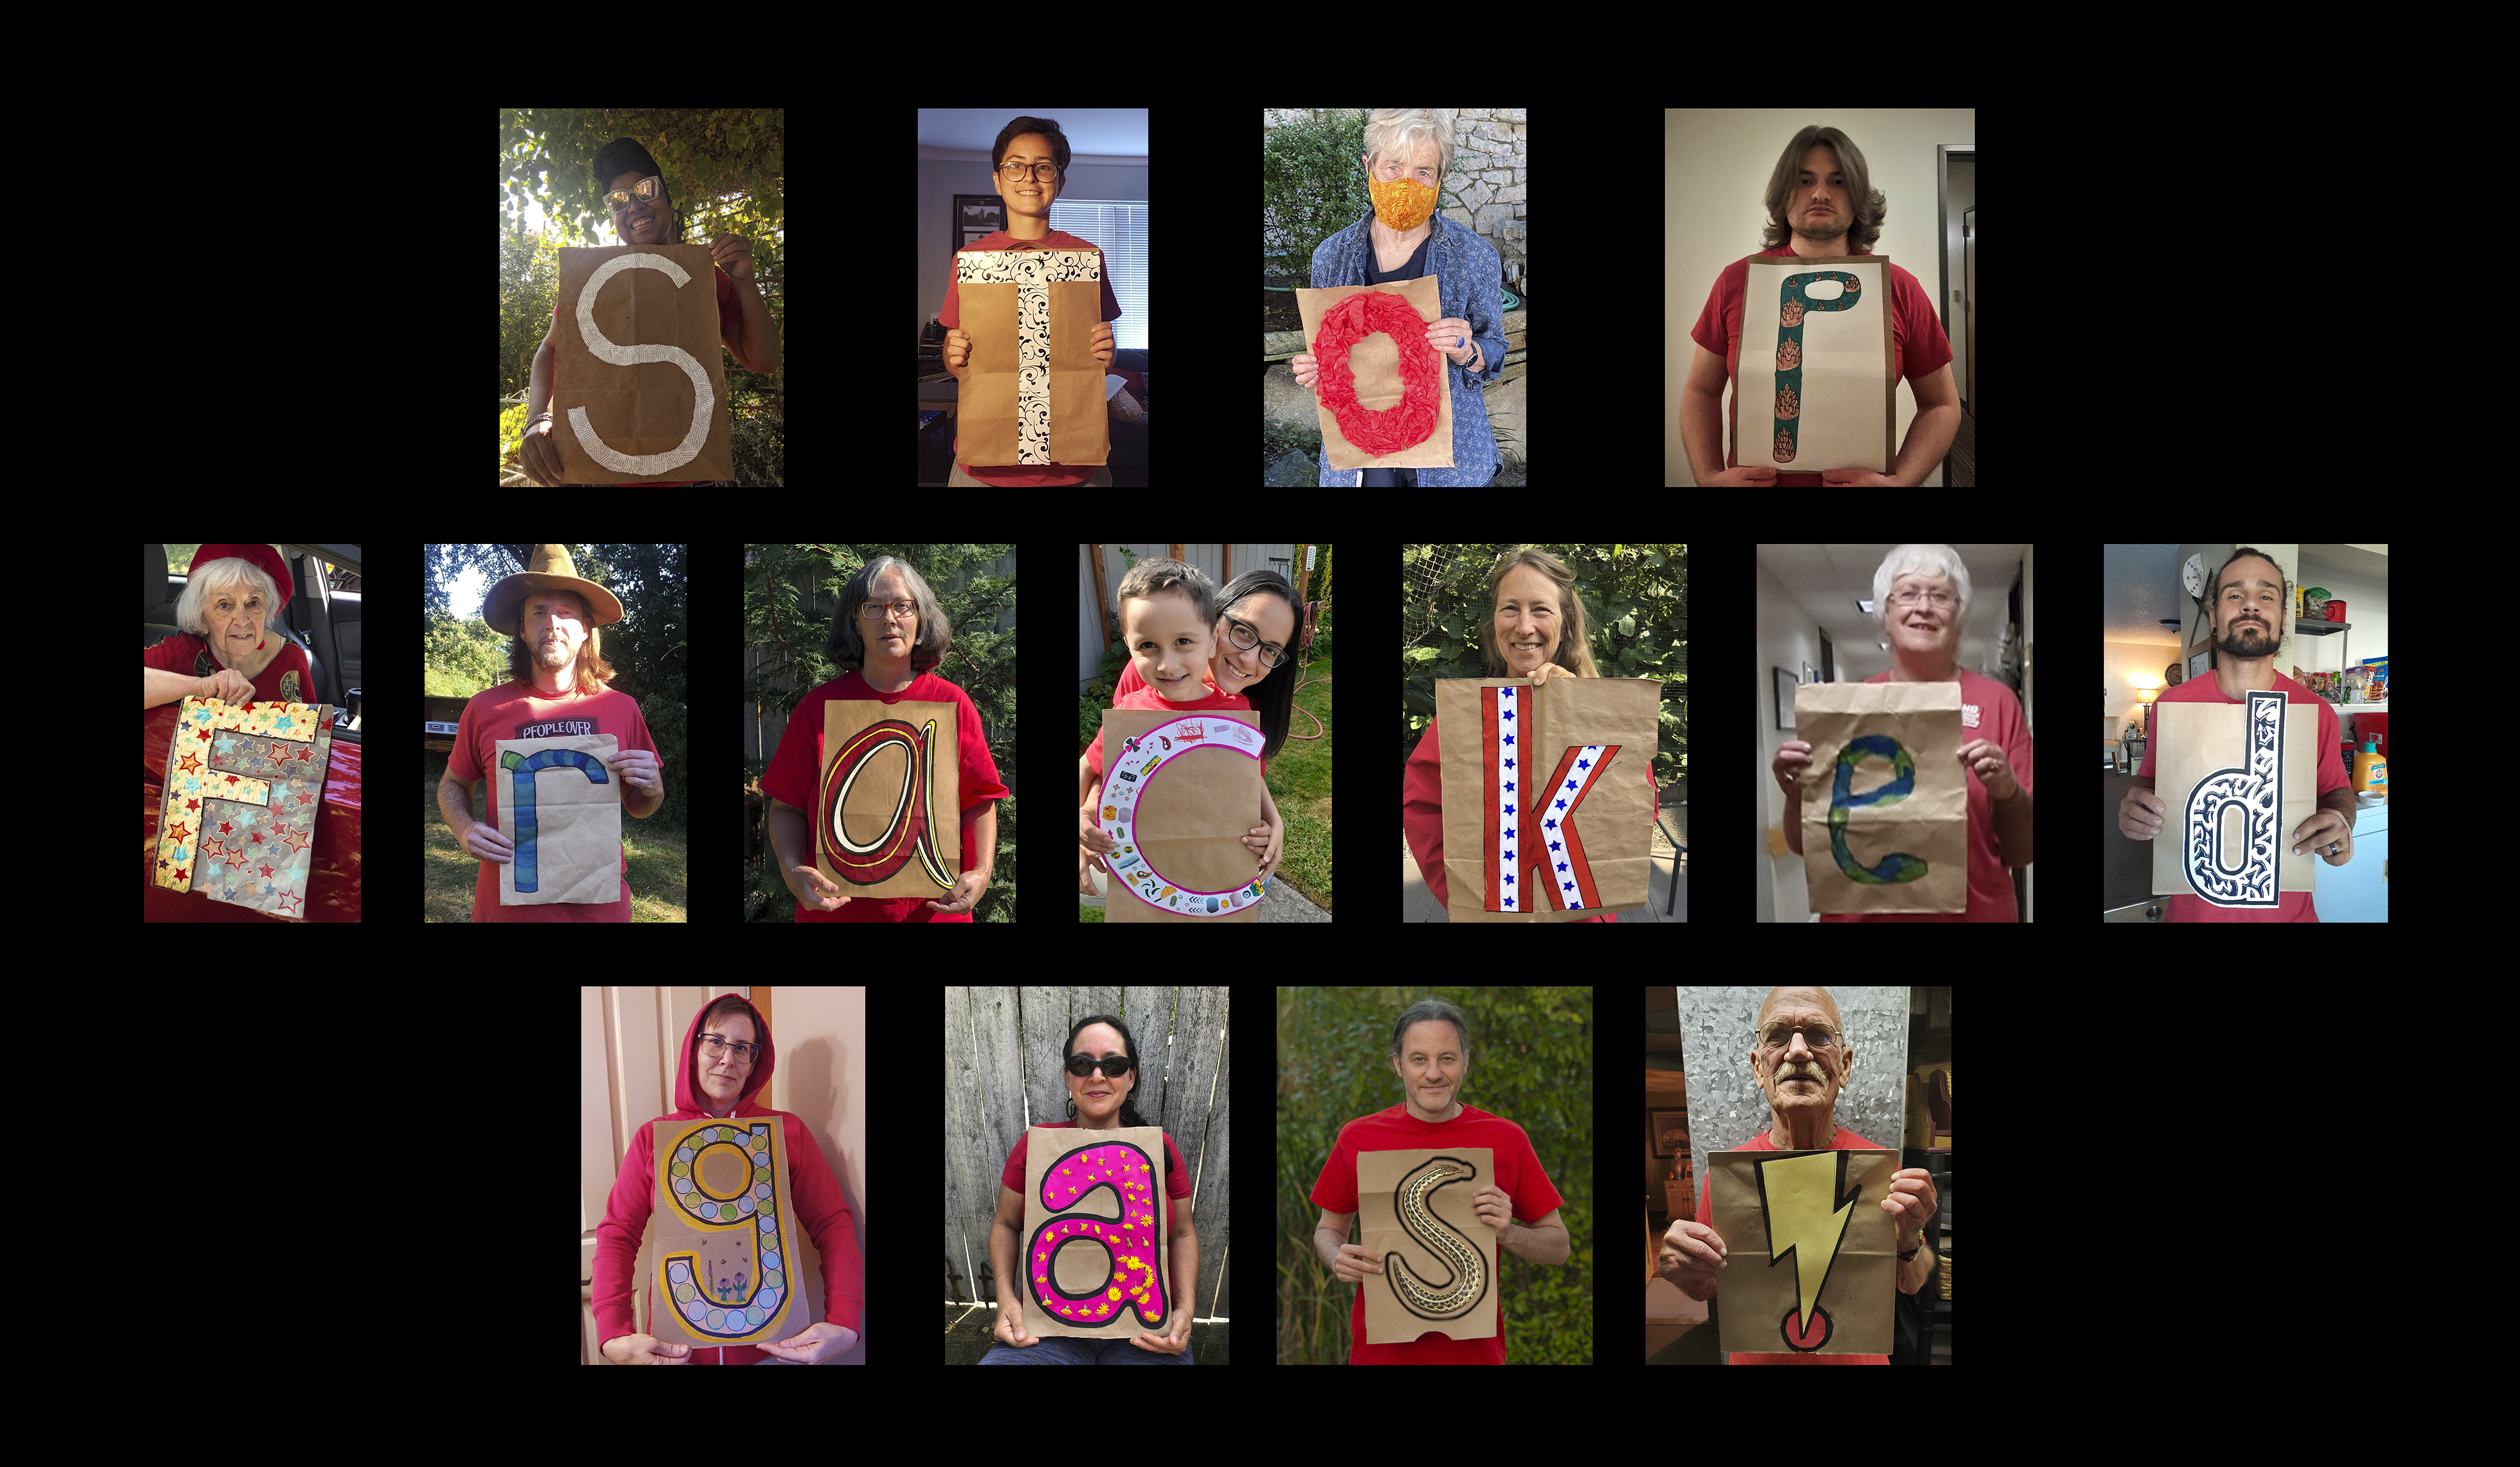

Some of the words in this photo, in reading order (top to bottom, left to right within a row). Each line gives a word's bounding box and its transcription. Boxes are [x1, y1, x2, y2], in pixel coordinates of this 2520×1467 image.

[957, 251, 1101, 465] T
[1773, 270, 1862, 463] P
[154, 696, 322, 894] F
[501, 749, 610, 893] r
[523, 722, 565, 739] PEOPLE
[565, 721, 591, 735] OVER
[819, 719, 956, 890] a
[1828, 735, 1928, 885] e
[2184, 691, 2286, 906] d
[665, 1121, 789, 1340] g
[1026, 1140, 1168, 1330] a
